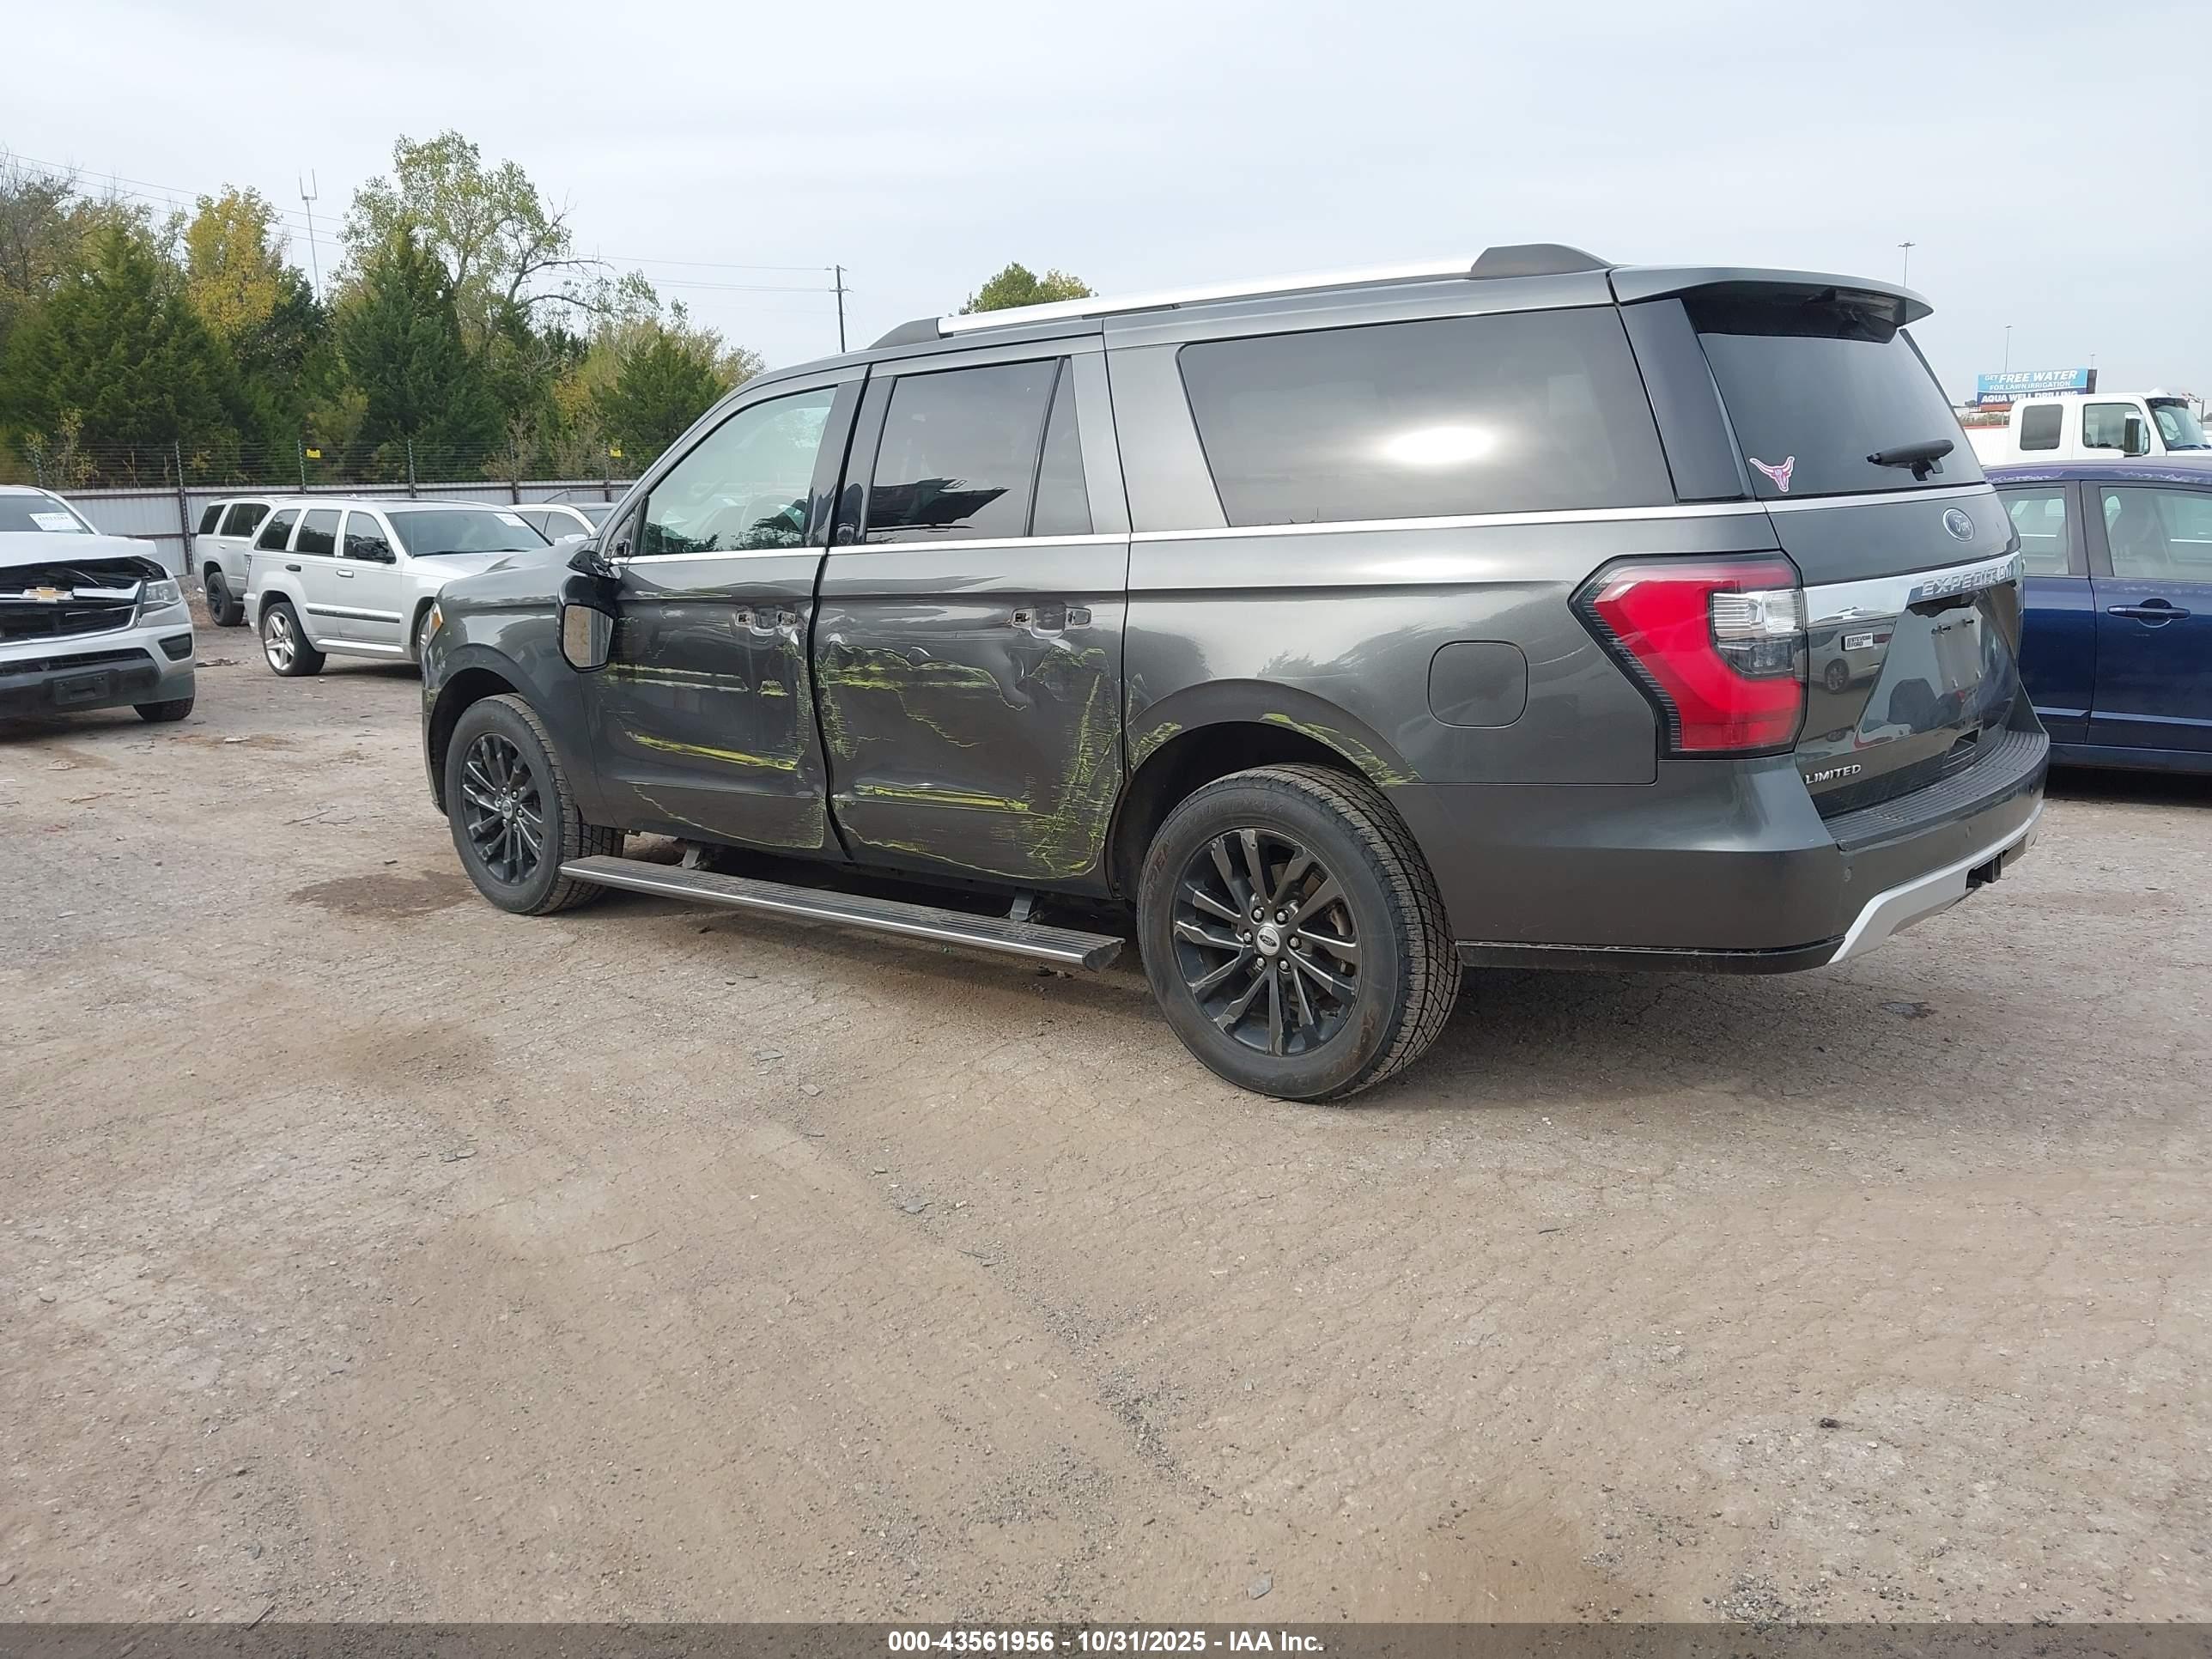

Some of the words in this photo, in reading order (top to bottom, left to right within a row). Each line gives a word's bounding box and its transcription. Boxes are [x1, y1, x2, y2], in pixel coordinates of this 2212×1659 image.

[1999, 373, 2032, 384] FREE
[2033, 370, 2078, 381] WATER
[1981, 394, 2008, 404] AQUA
[1954, 514, 1971, 532] Ford
[1805, 764, 1862, 785] LIMITED
